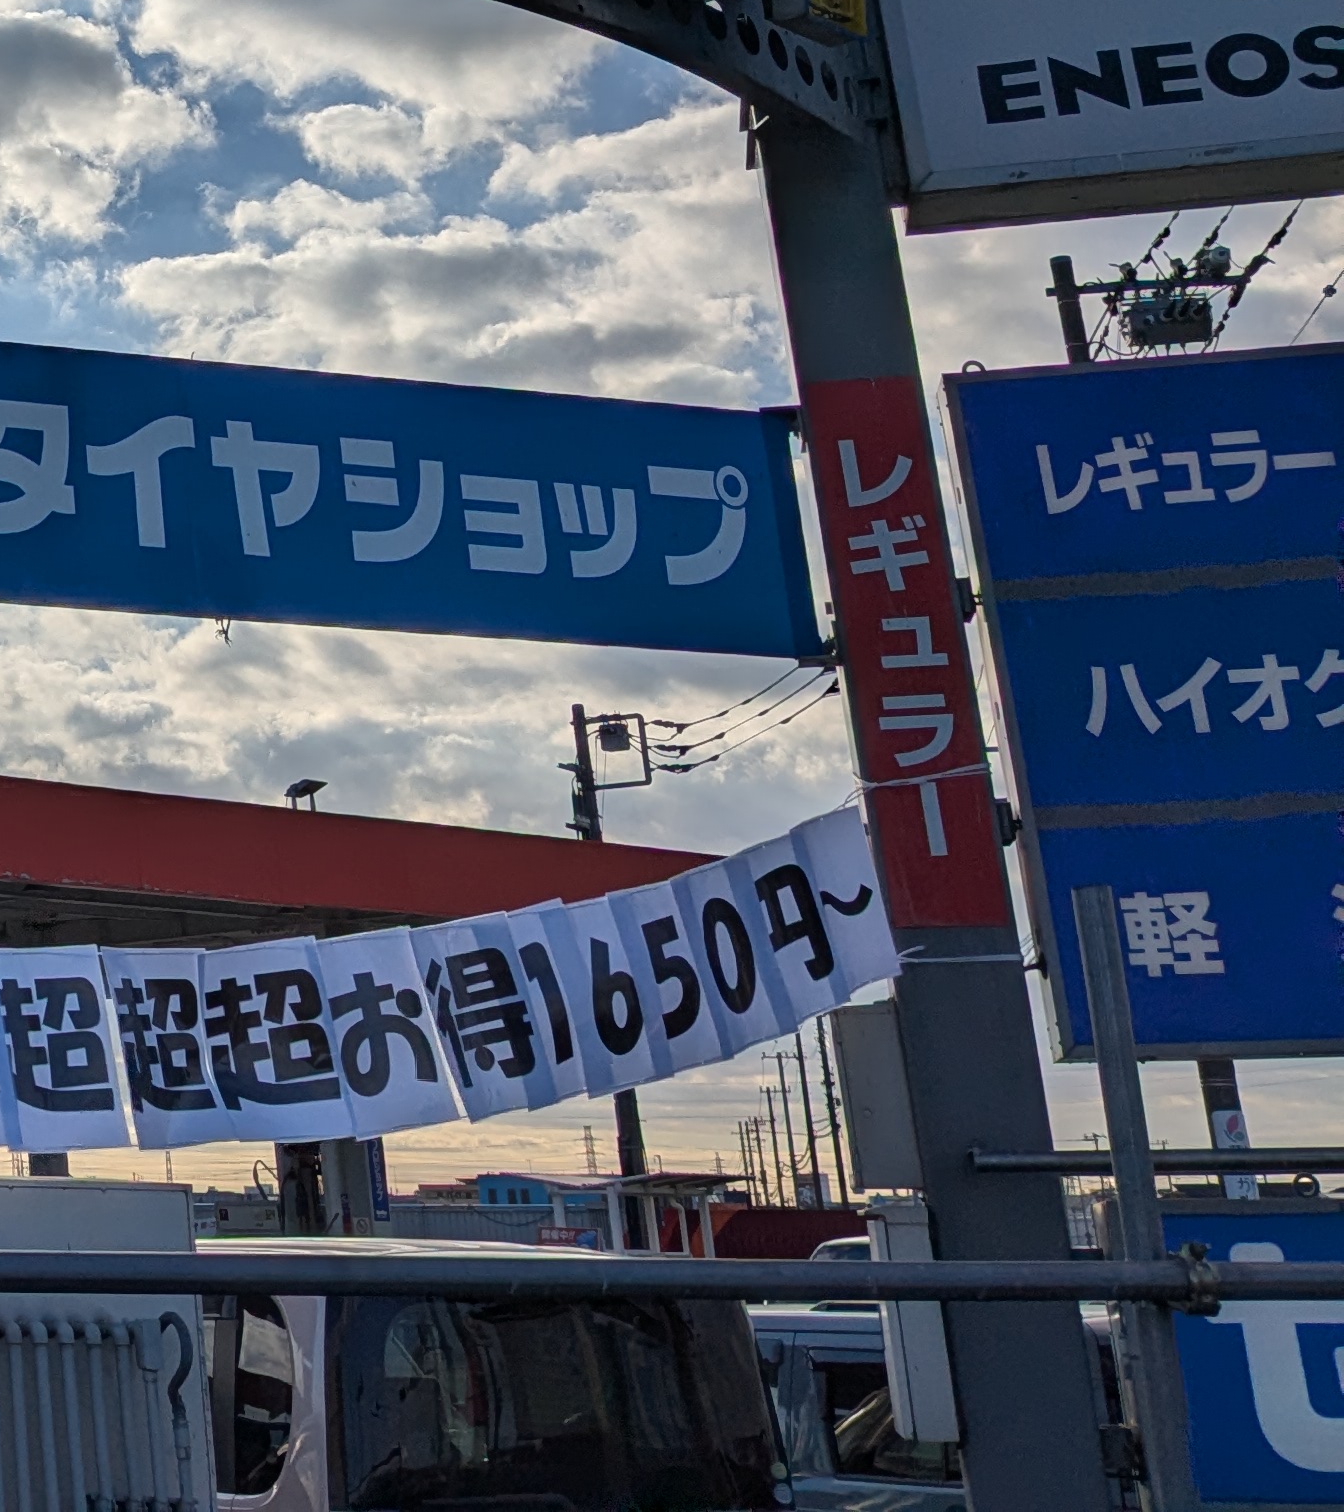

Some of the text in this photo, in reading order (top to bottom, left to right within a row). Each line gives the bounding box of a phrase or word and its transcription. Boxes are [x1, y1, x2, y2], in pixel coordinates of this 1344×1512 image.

[1035, 429, 1336, 515] レギュラー
[837, 438, 955, 857] レギュラー
